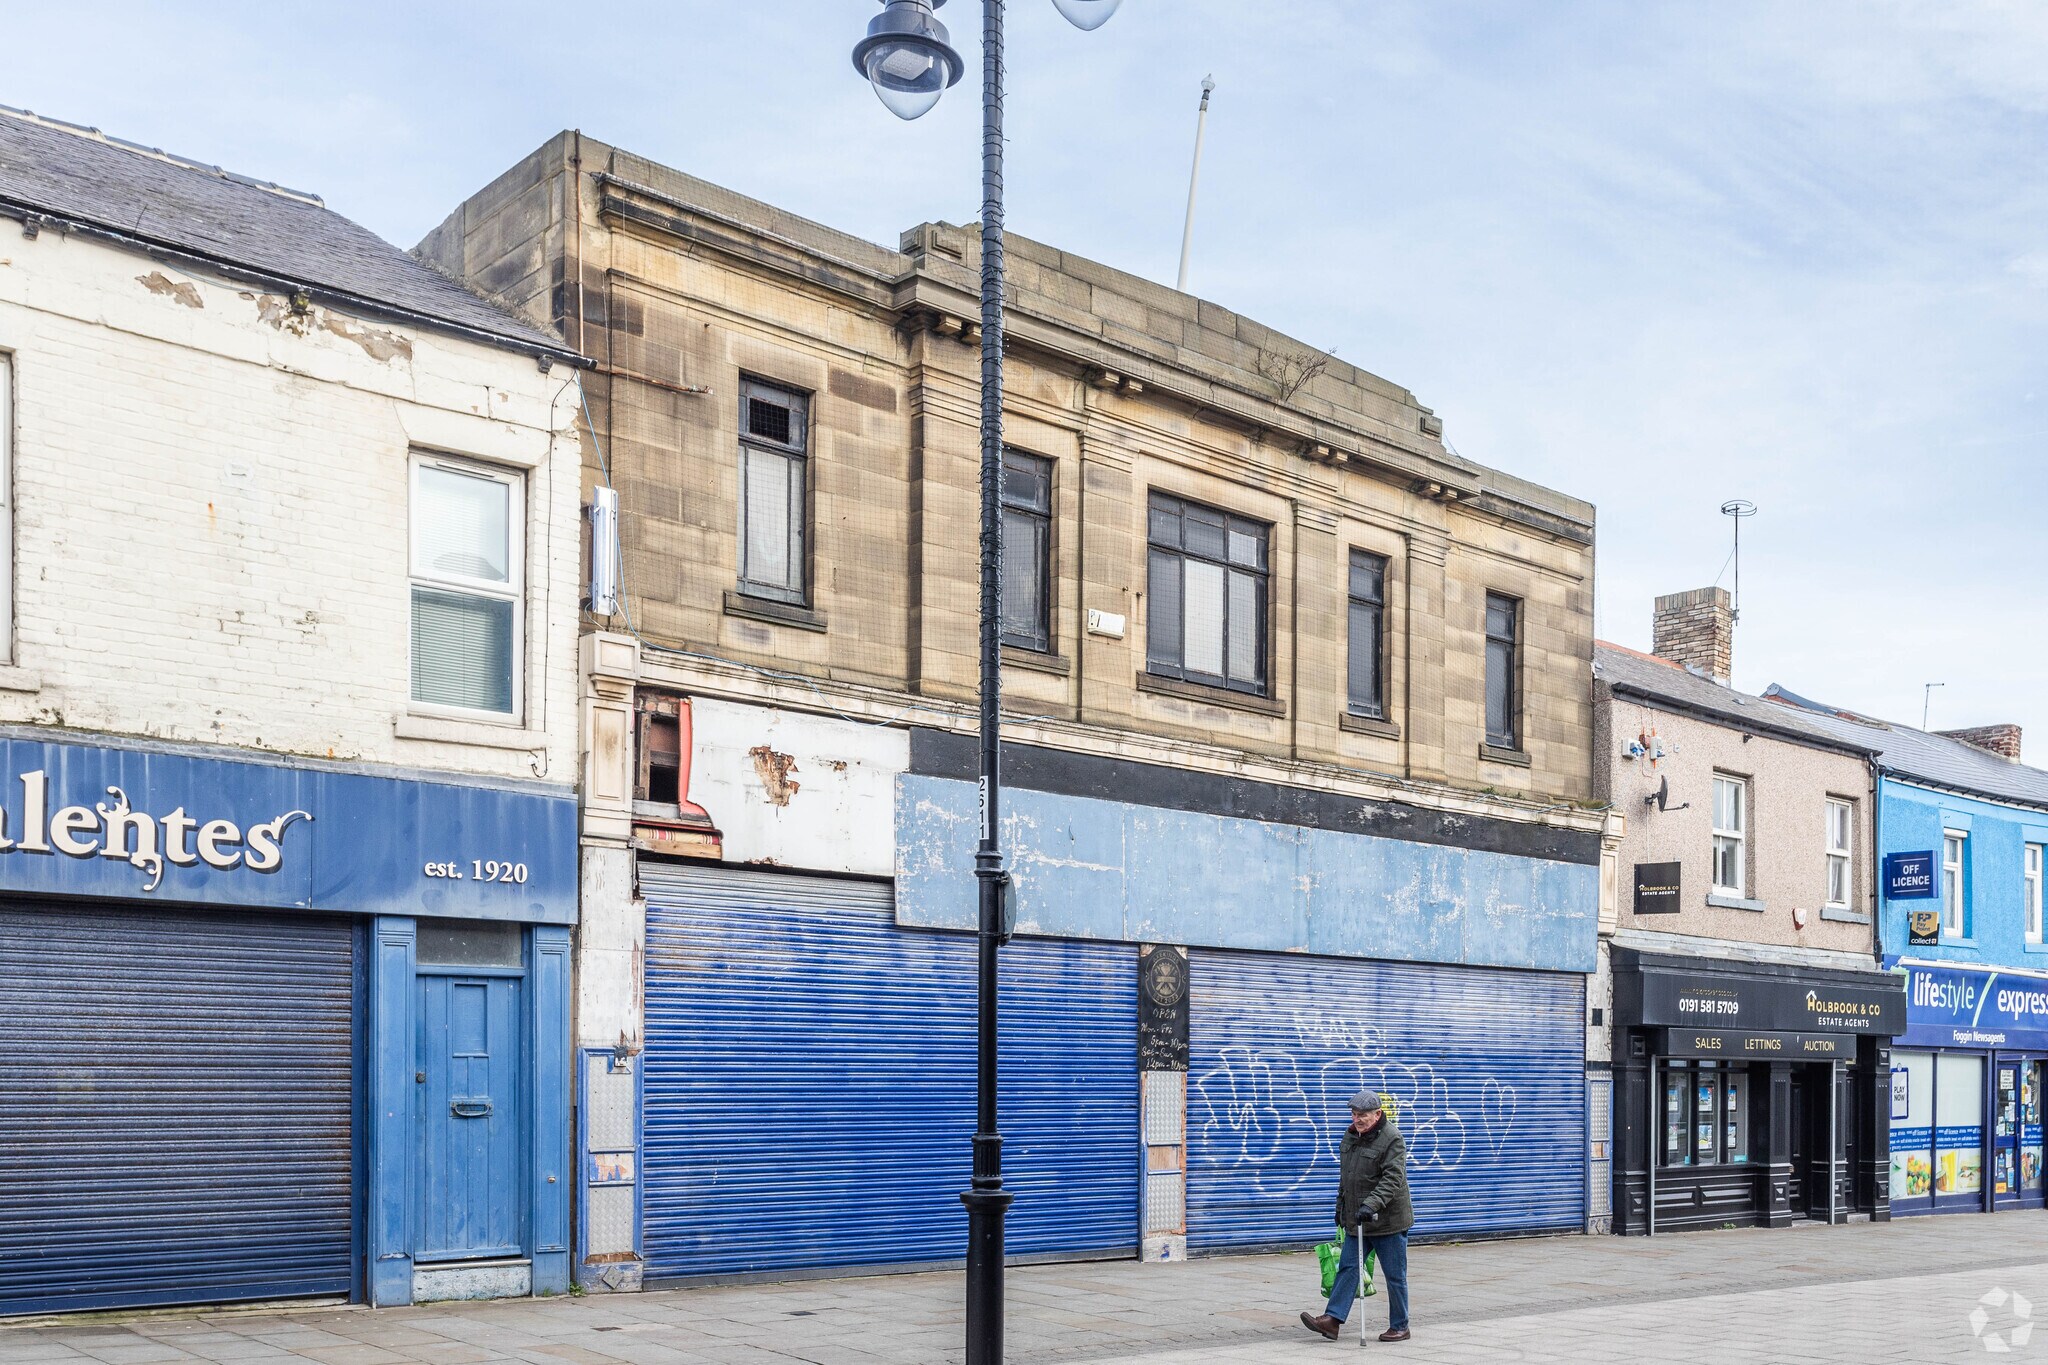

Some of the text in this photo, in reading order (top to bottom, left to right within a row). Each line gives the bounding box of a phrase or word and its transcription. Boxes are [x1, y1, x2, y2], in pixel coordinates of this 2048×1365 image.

[0, 770, 311, 891] lentes
[424, 860, 528, 883] est. 1920
[1903, 864, 1920, 875] OFF
[1892, 875, 1930, 887] LICENCE
[1914, 972, 1975, 1016] lifestyle
[1679, 998, 1739, 1015] 0191 581 5709
[1807, 998, 1881, 1016] HOLBROOK & CO
[1818, 1017, 1870, 1028] ESTATE AGENTS
[1695, 1037, 1835, 1051] SALES LETTINGS AUCTION
[1953, 1030, 2005, 1045] Foggin Newsagents
[1893, 1086, 1905, 1094] PLAY
[1893, 1094, 1905, 1102] NOW
